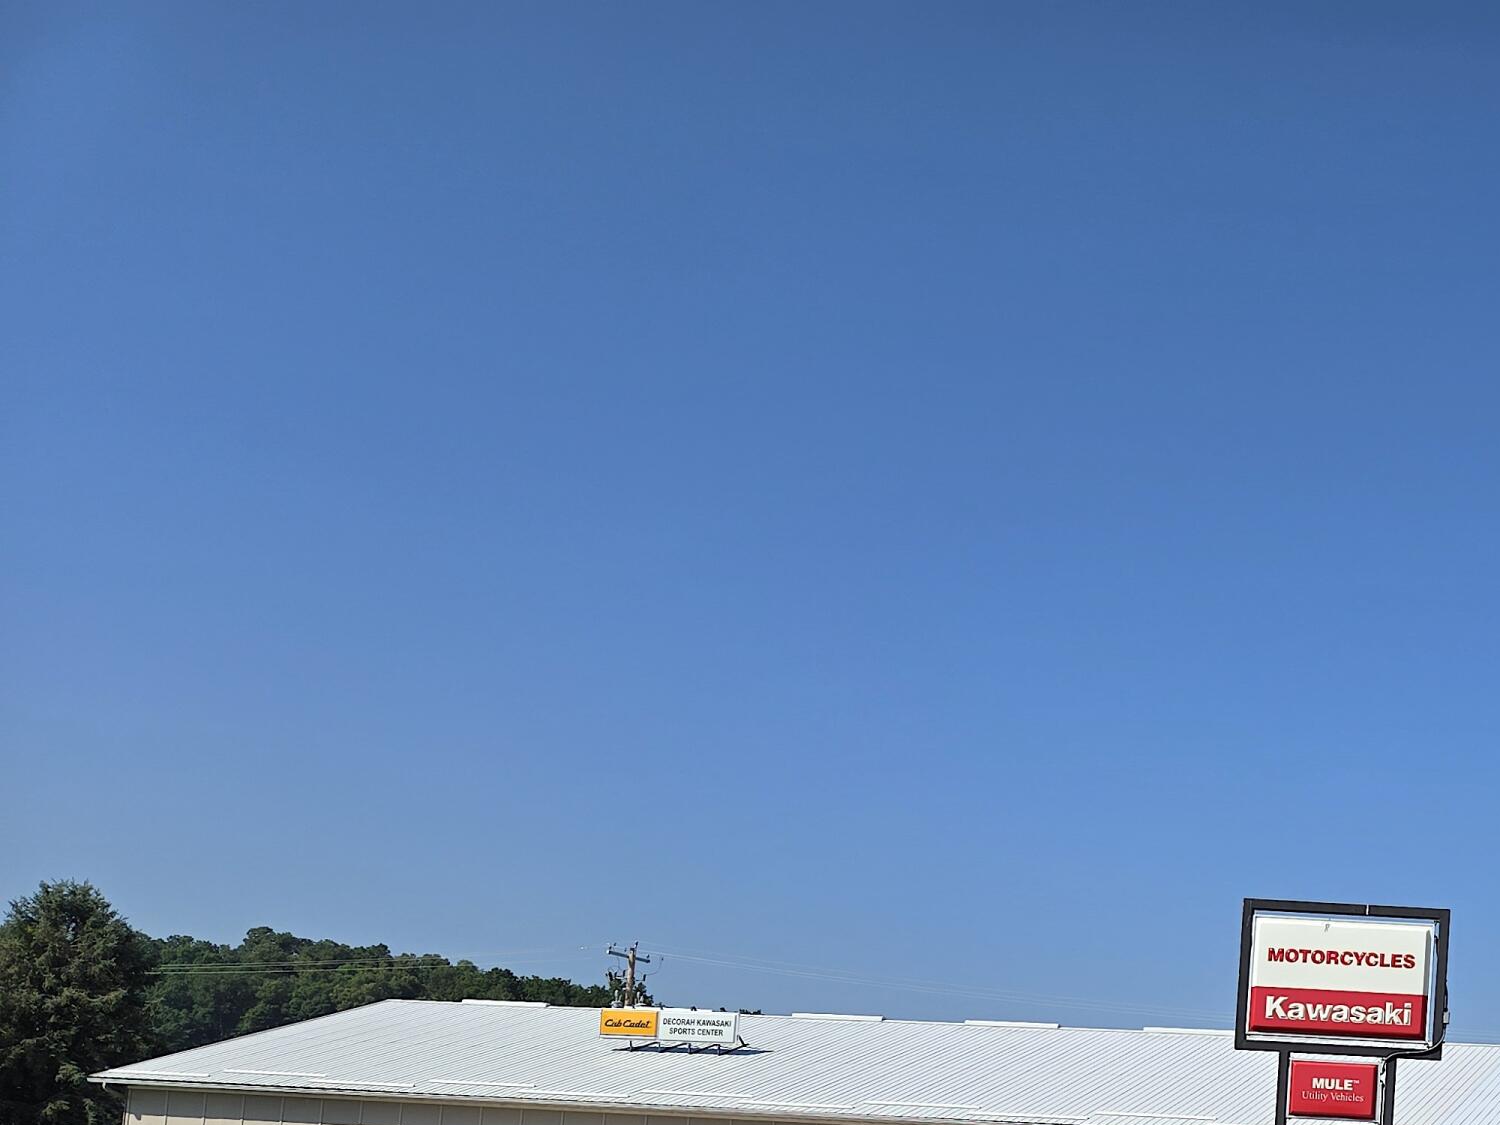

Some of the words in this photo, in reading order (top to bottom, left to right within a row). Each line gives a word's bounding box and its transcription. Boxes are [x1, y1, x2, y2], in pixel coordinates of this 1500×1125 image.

[1267, 947, 1416, 969] MOTORCYCLES
[1265, 995, 1412, 1026] Kawasaki
[604, 1018, 622, 1028] Cub
[623, 1019, 650, 1029] Cadet
[662, 1017, 695, 1027] DECORAH
[696, 1019, 732, 1028] KAWASAKI
[669, 1027, 696, 1036] SPORTS
[697, 1028, 724, 1037] CENTER
[1302, 1091, 1329, 1103] Utility
[1330, 1091, 1365, 1103] Vehicles
